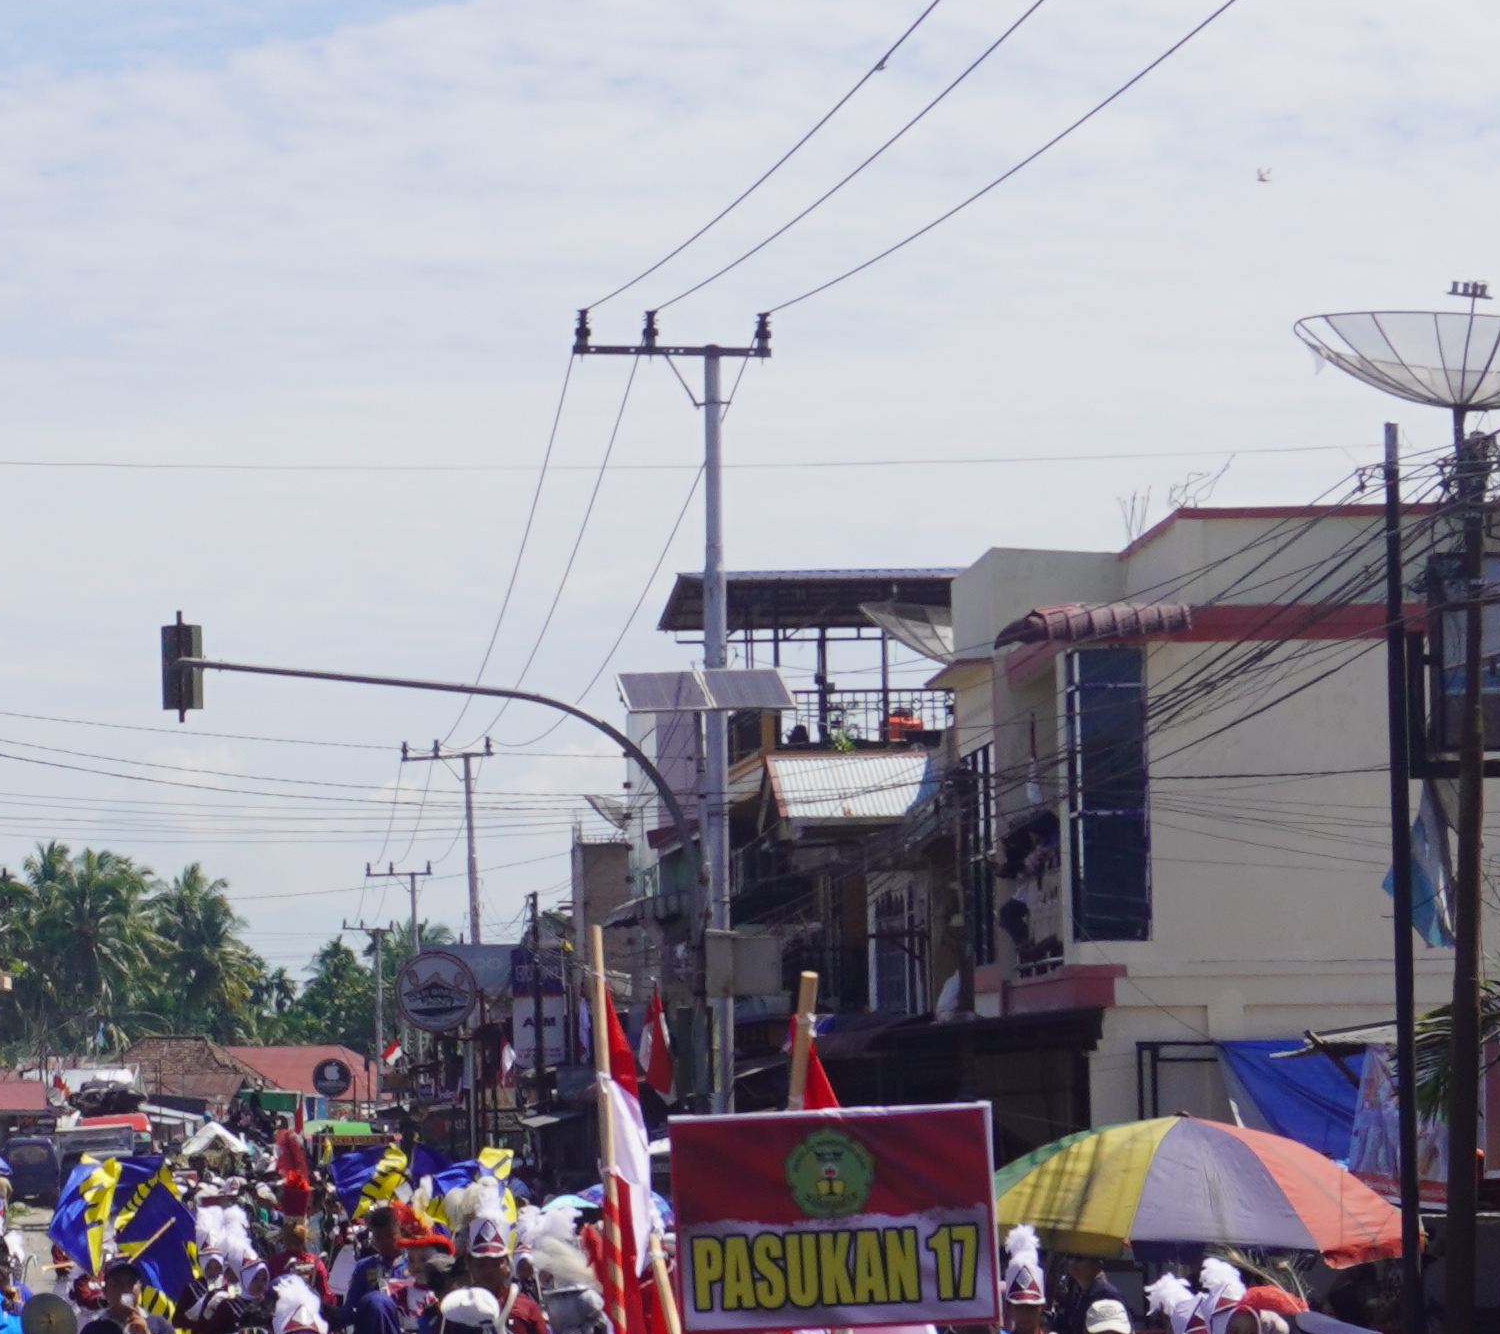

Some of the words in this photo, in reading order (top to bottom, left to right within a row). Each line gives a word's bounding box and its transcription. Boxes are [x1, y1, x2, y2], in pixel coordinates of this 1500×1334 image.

[523, 1017, 556, 1028] AM
[691, 1226, 923, 1313] PASUKAN
[926, 1221, 979, 1302] 17
